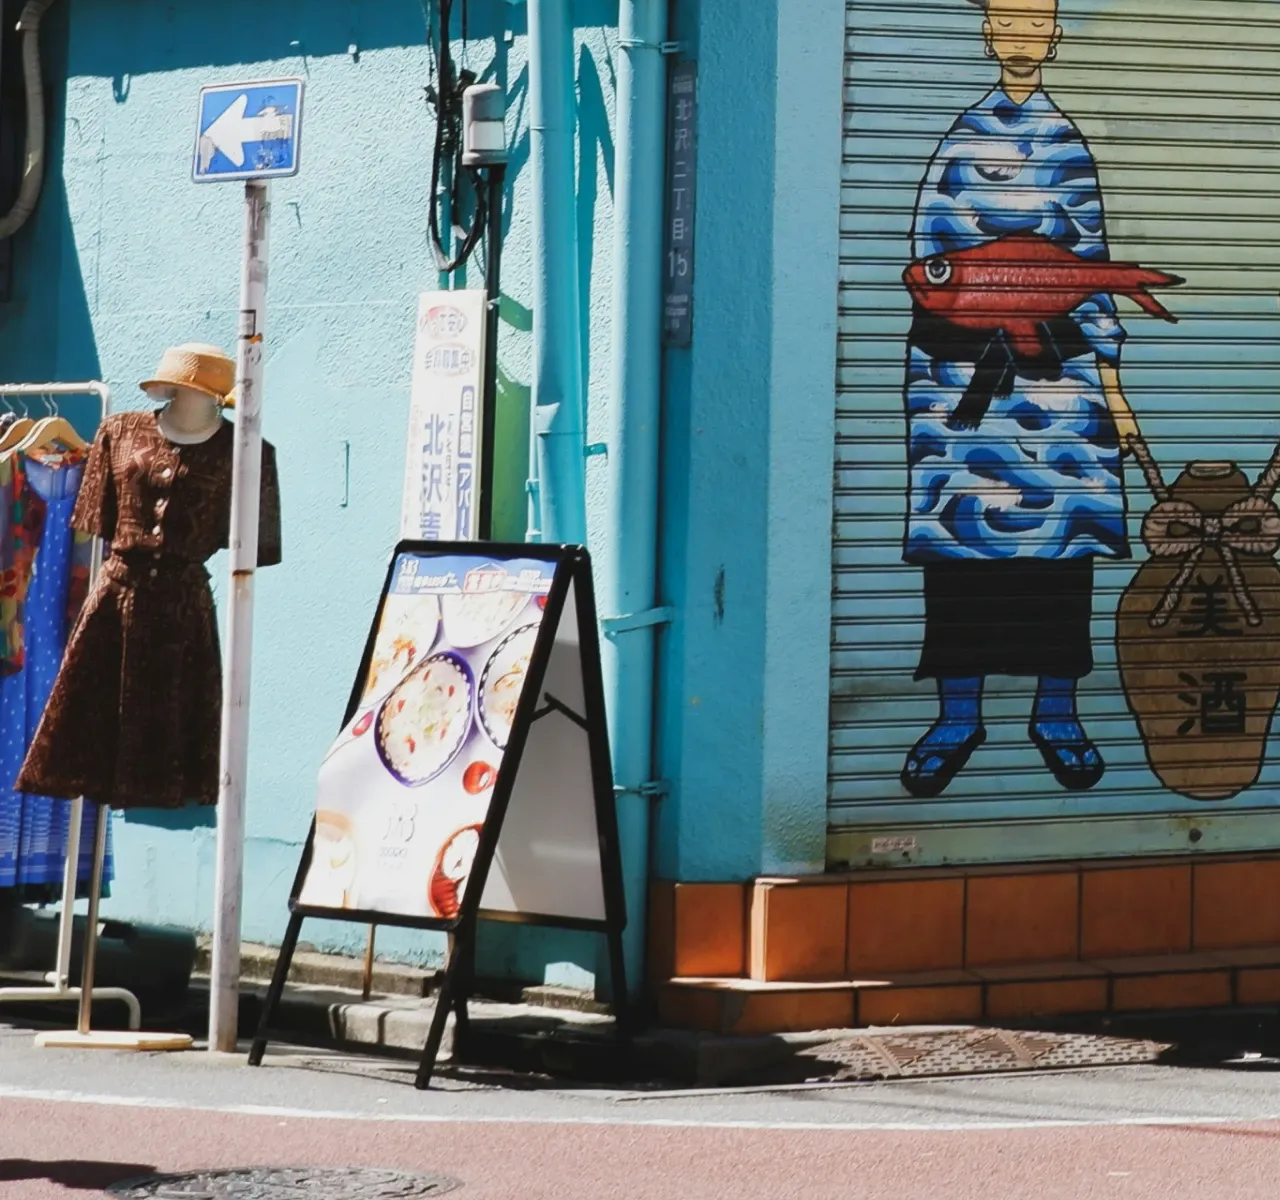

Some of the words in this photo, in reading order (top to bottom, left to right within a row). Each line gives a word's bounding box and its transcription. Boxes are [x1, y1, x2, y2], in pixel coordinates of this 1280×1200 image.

[672, 99, 693, 240] 北沢二丁目
